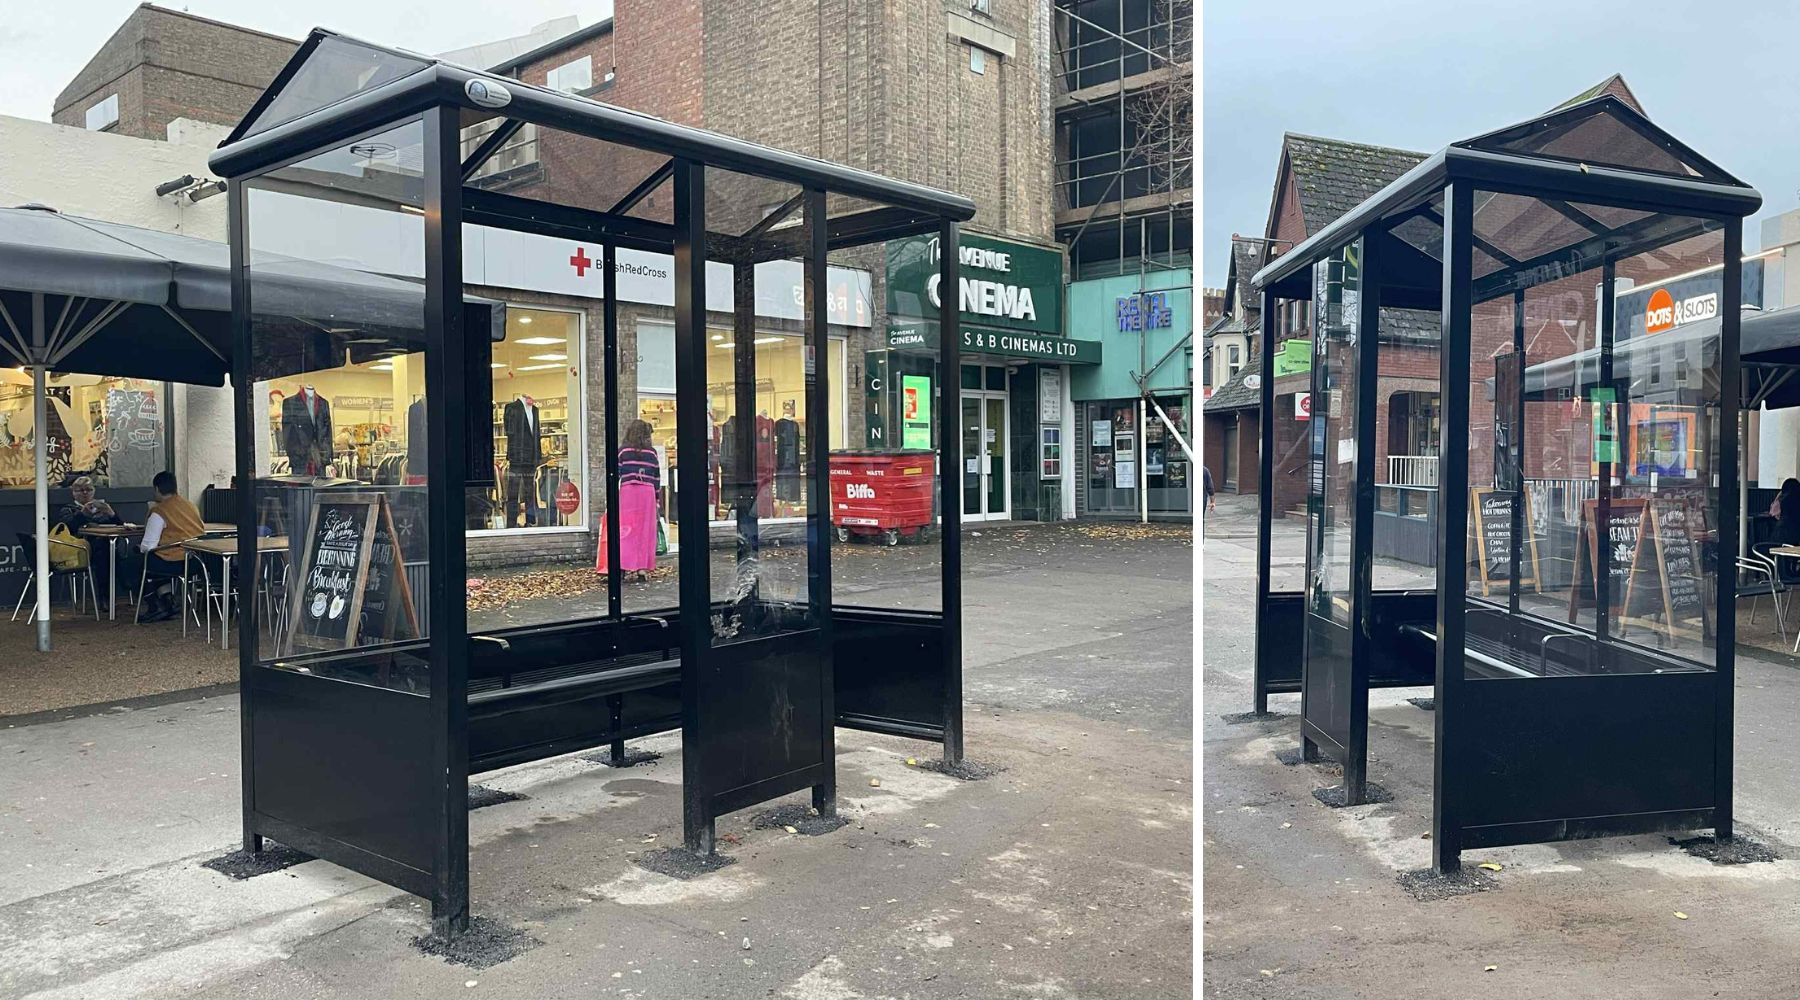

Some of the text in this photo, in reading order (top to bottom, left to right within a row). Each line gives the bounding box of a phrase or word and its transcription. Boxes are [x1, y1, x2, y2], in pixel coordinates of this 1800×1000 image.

[958, 246, 1011, 272] VENUE
[928, 273, 1036, 321] CNEMA
[1647, 297, 1715, 327] DOTS & SLOTS
[890, 335, 924, 345] CINEMA
[964, 332, 1077, 356] S & B CINEMAS LTD
[846, 484, 875, 498] Biffa
